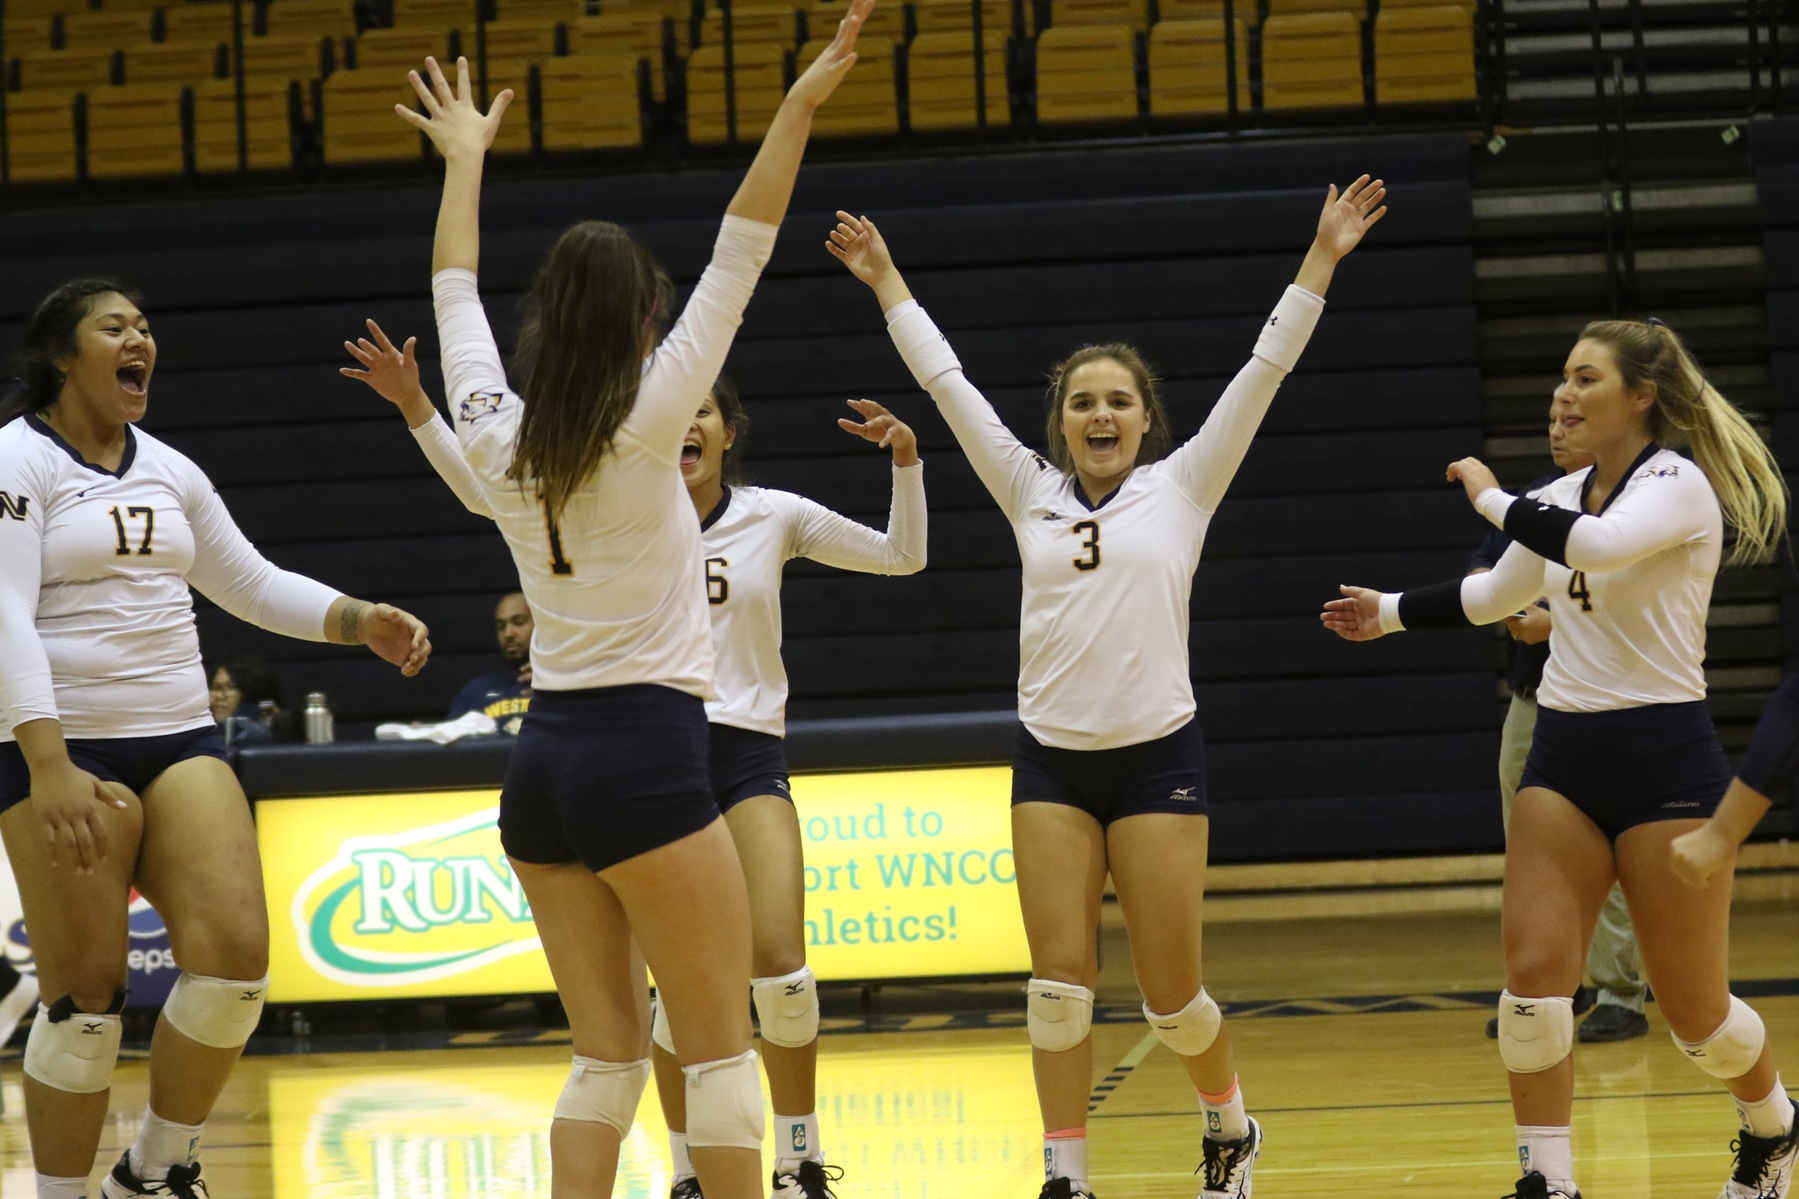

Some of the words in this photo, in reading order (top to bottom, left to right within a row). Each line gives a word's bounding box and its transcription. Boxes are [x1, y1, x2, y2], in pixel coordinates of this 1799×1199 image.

[109, 506, 155, 556] 17
[1073, 521, 1101, 572] 3
[705, 557, 731, 606] 6
[1568, 570, 1594, 612] 4
[484, 698, 531, 718] WEST
[797, 802, 888, 842] oud
[903, 806, 944, 839] to
[352, 847, 535, 935] RUN
[804, 857, 862, 893] ort
[875, 847, 1017, 889] WNCC
[128, 948, 176, 975] eps
